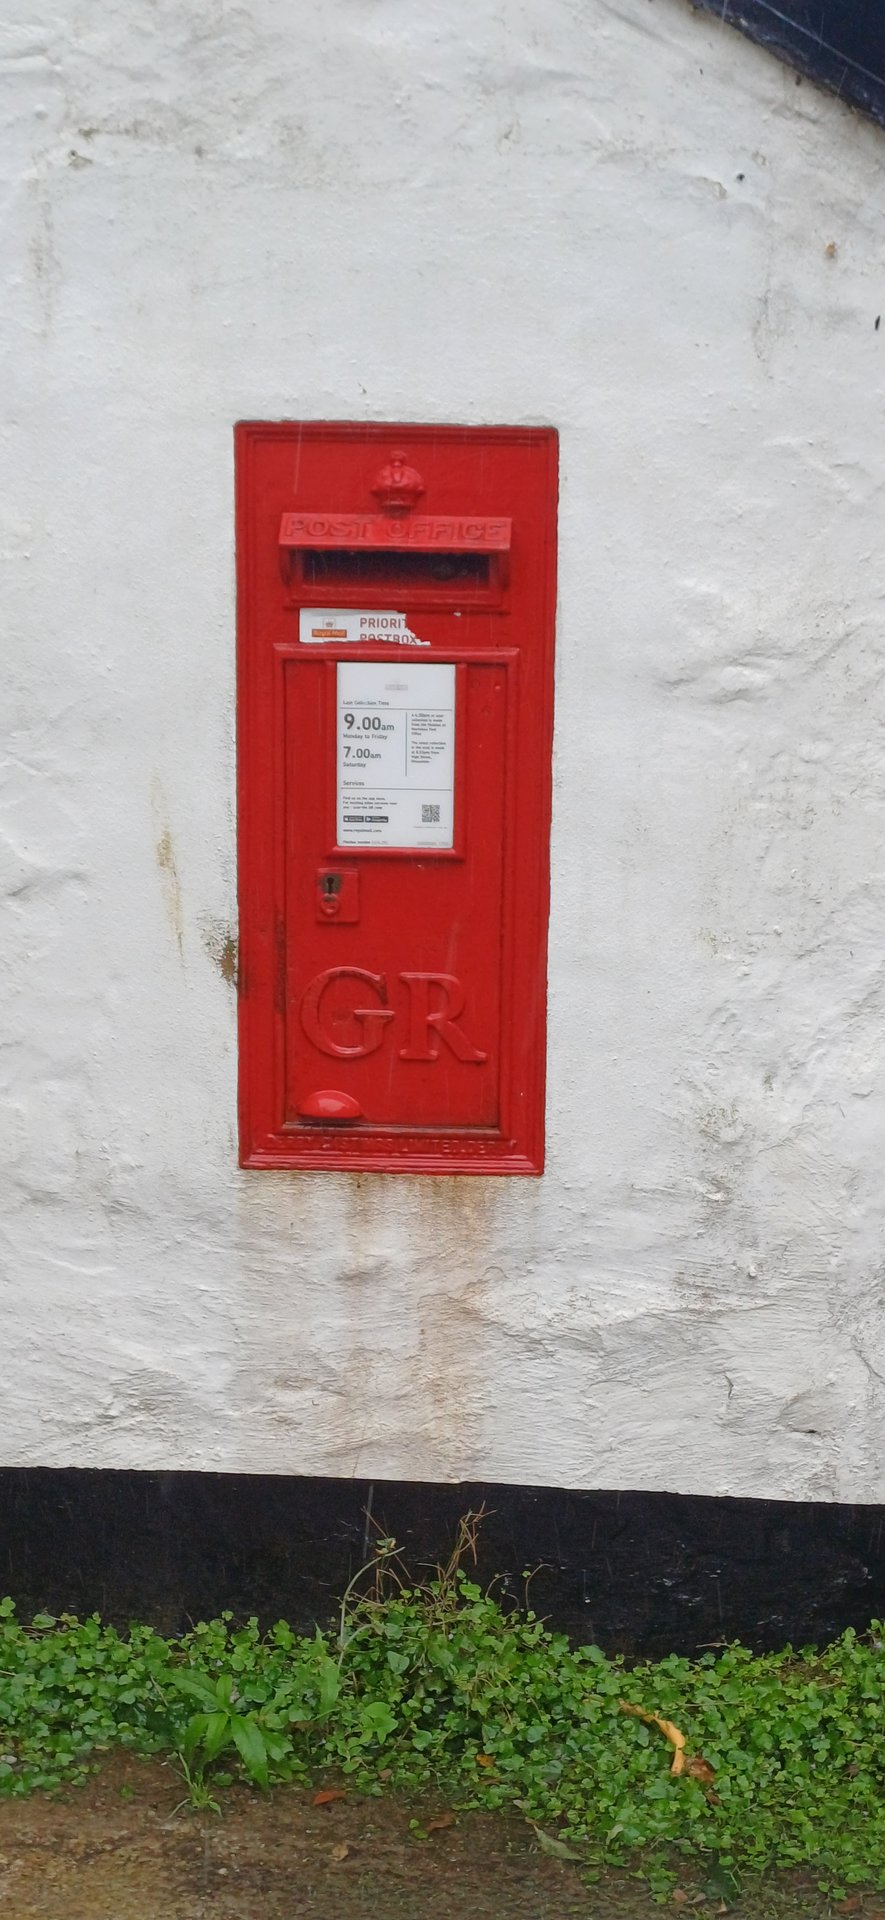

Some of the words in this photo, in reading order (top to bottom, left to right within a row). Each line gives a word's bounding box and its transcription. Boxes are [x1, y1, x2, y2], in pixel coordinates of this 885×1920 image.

[285, 519, 373, 538] POST
[387, 520, 506, 542] OFFICE
[344, 713, 395, 731] 9.00am
[343, 746, 382, 759] 7.00am
[300, 966, 488, 1063] GR
